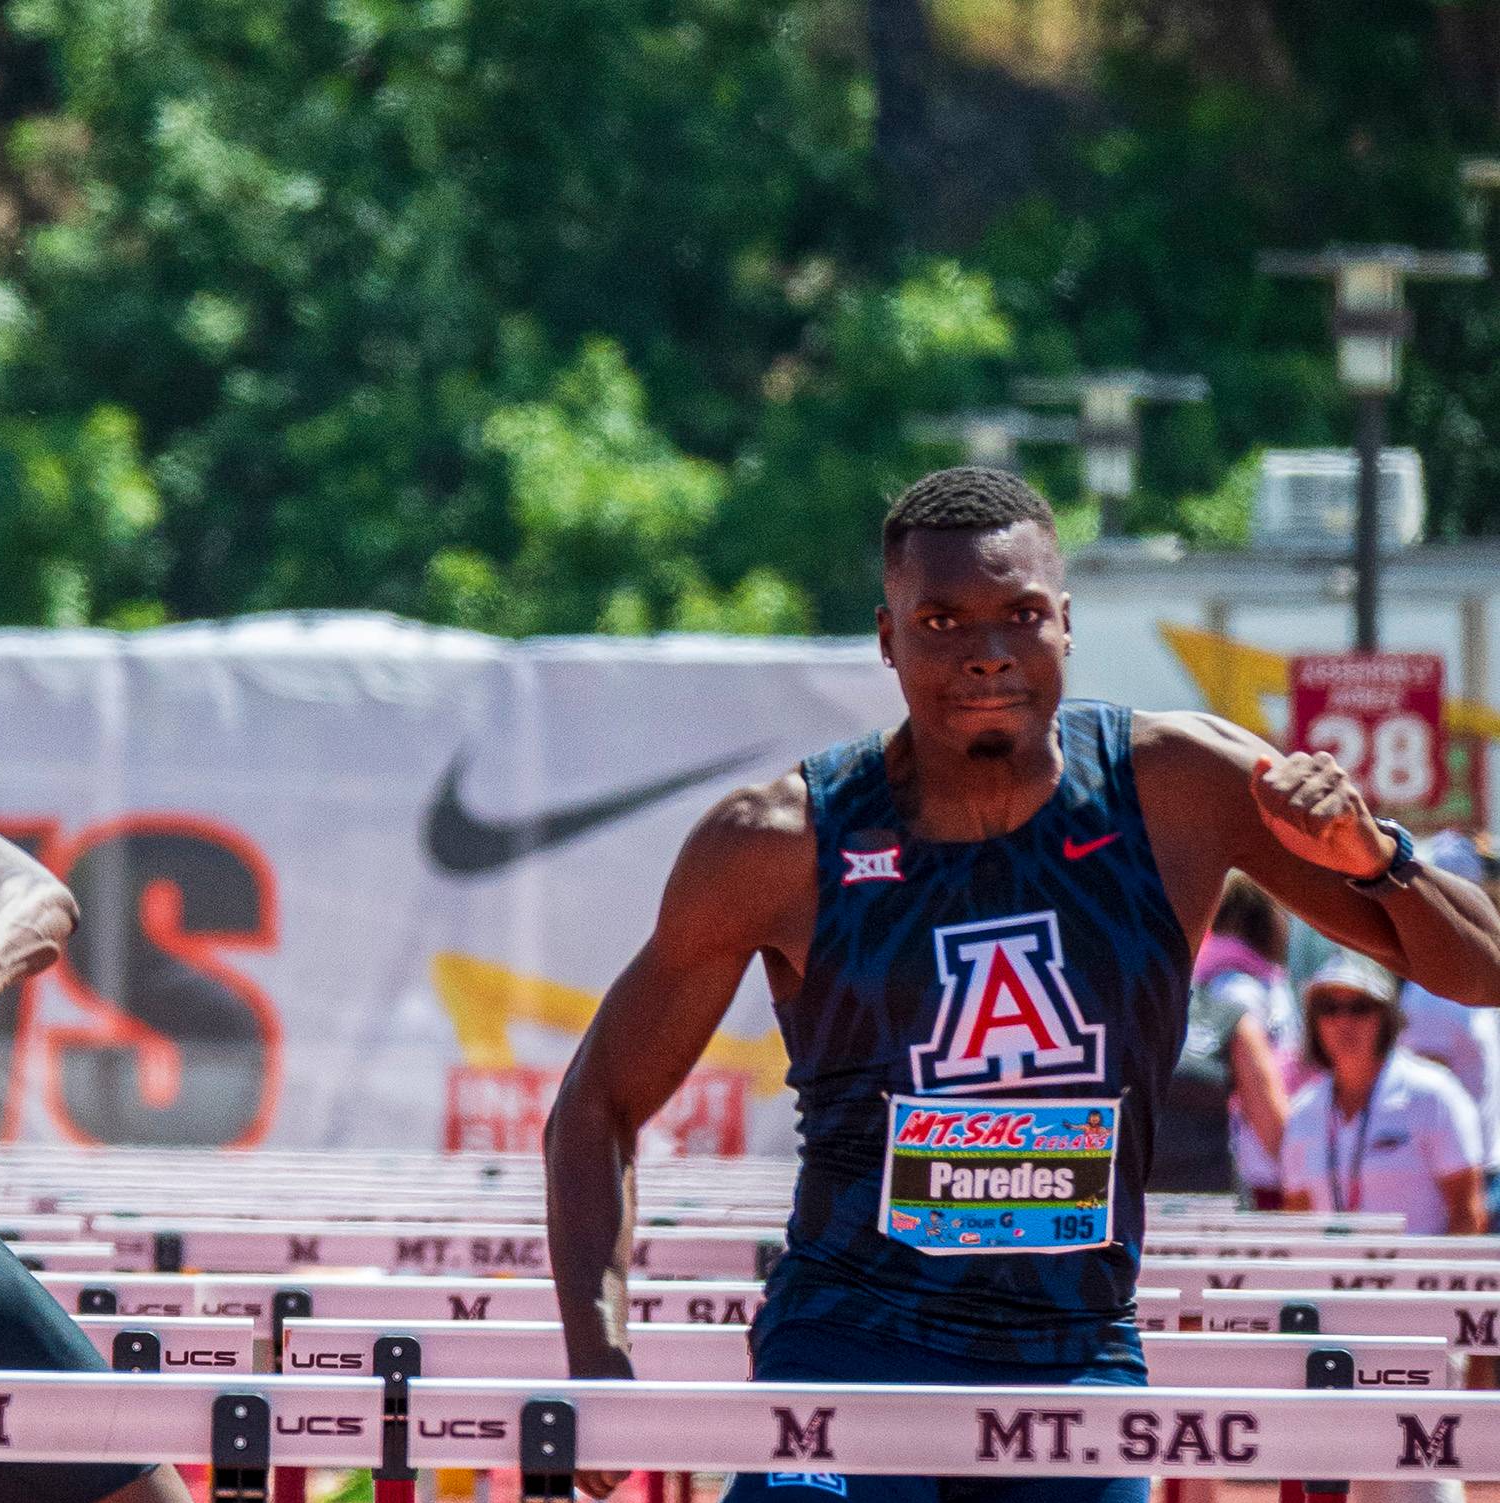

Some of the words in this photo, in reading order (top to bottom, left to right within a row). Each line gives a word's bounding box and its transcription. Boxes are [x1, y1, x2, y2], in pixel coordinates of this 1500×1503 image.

[910, 911, 1106, 1094] A
[929, 1161, 1074, 1199] Paredes
[1052, 1214, 1095, 1241] 195
[165, 1349, 237, 1368] UCS
[290, 1352, 364, 1370] UCS
[1357, 1368, 1432, 1386] UCS
[277, 1416, 364, 1436] UCS
[420, 1419, 506, 1439] UCS
[771, 1407, 837, 1462] M
[976, 1408, 1100, 1464] MT.
[1119, 1410, 1260, 1467] SAC
[1396, 1413, 1463, 1469] M
